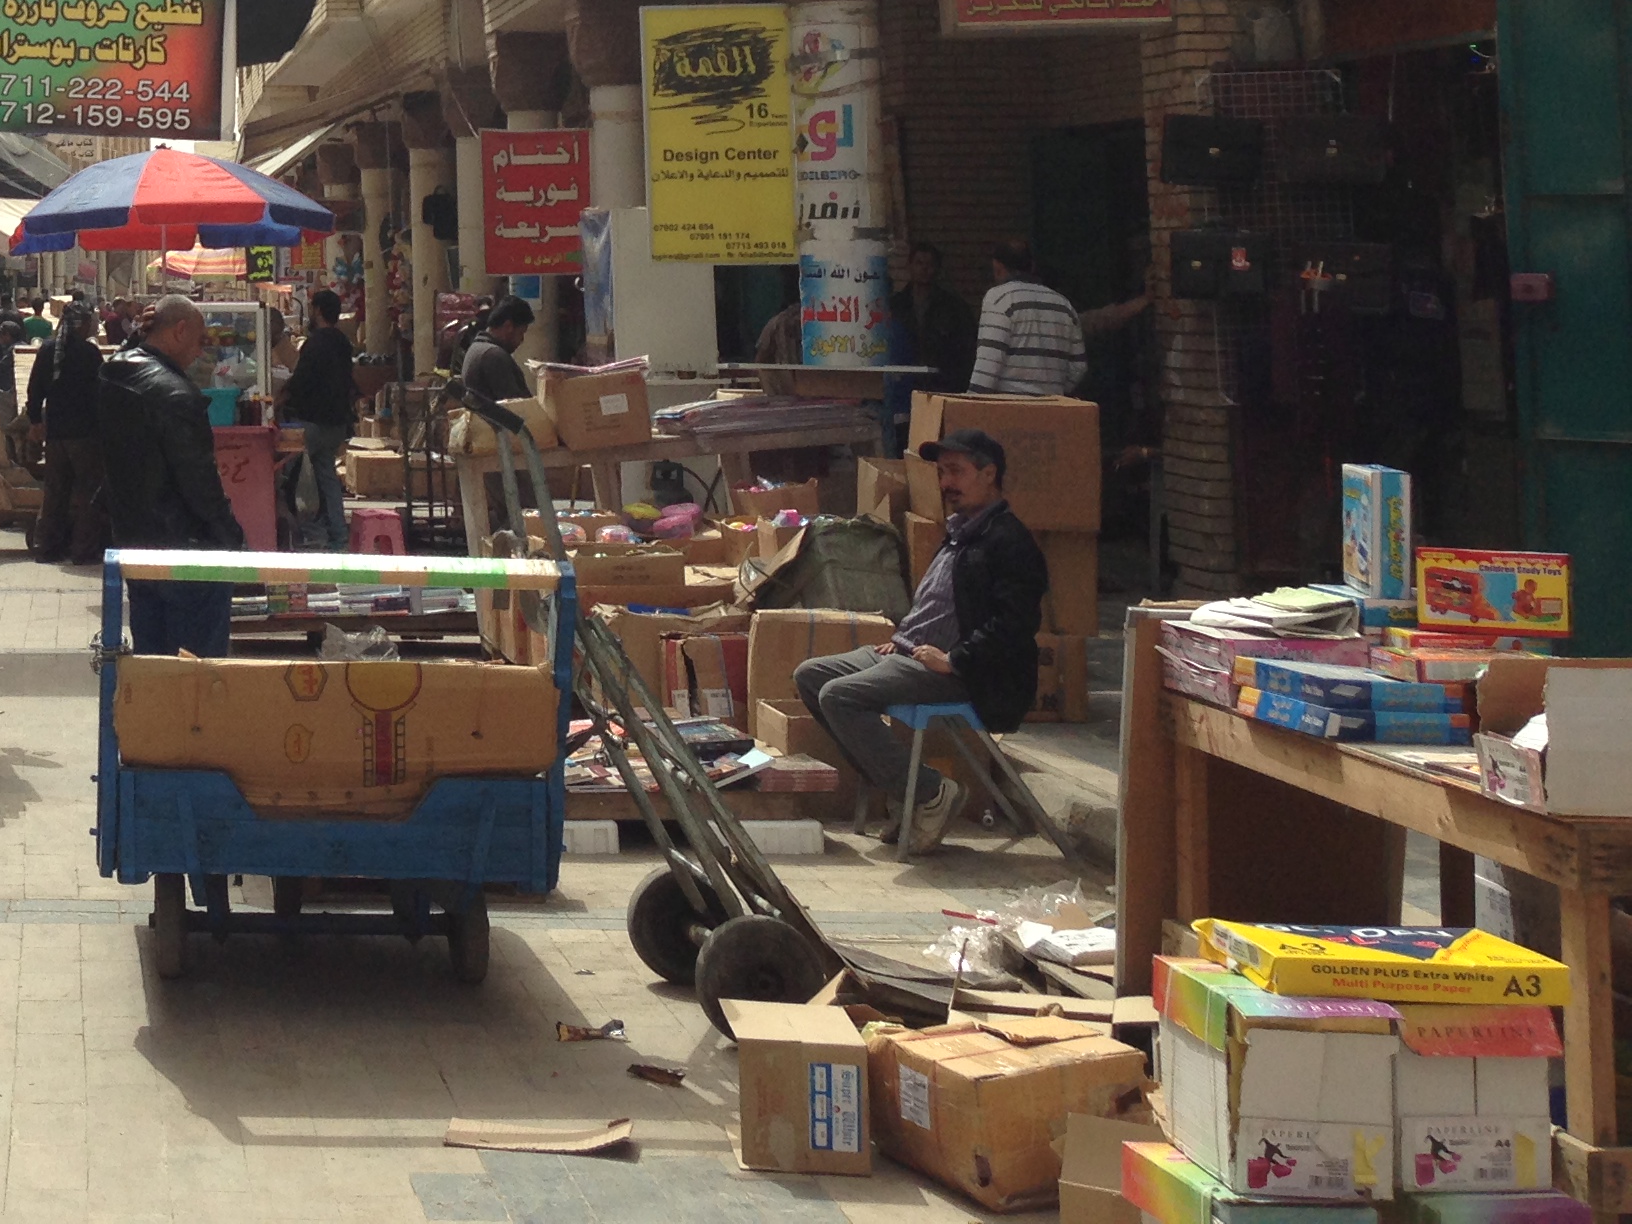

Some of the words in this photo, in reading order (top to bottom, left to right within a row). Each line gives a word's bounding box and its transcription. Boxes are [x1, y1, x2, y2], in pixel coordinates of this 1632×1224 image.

[93, 35, 166, 70] كارتات
[745, 103, 770, 119] 16
[663, 148, 720, 164] Design
[724, 147, 780, 161] Center
[495, 176, 579, 207] فورية
[1479, 563, 1516, 574] Children
[1517, 565, 1541, 576] Study
[1542, 566, 1563, 576] Toys
[1311, 964, 1370, 977] GOLDEN
[1376, 966, 1410, 979] PLUS
[1413, 970, 1450, 981] Extra
[1454, 972, 1495, 983] White
[1503, 973, 1544, 998] A3
[1331, 977, 1369, 990] Multi
[1373, 979, 1430, 994] Purpose
[1433, 982, 1473, 996] Paper
[1416, 1024, 1537, 1040] PAPERLINE
[1493, 1139, 1512, 1149] A4
